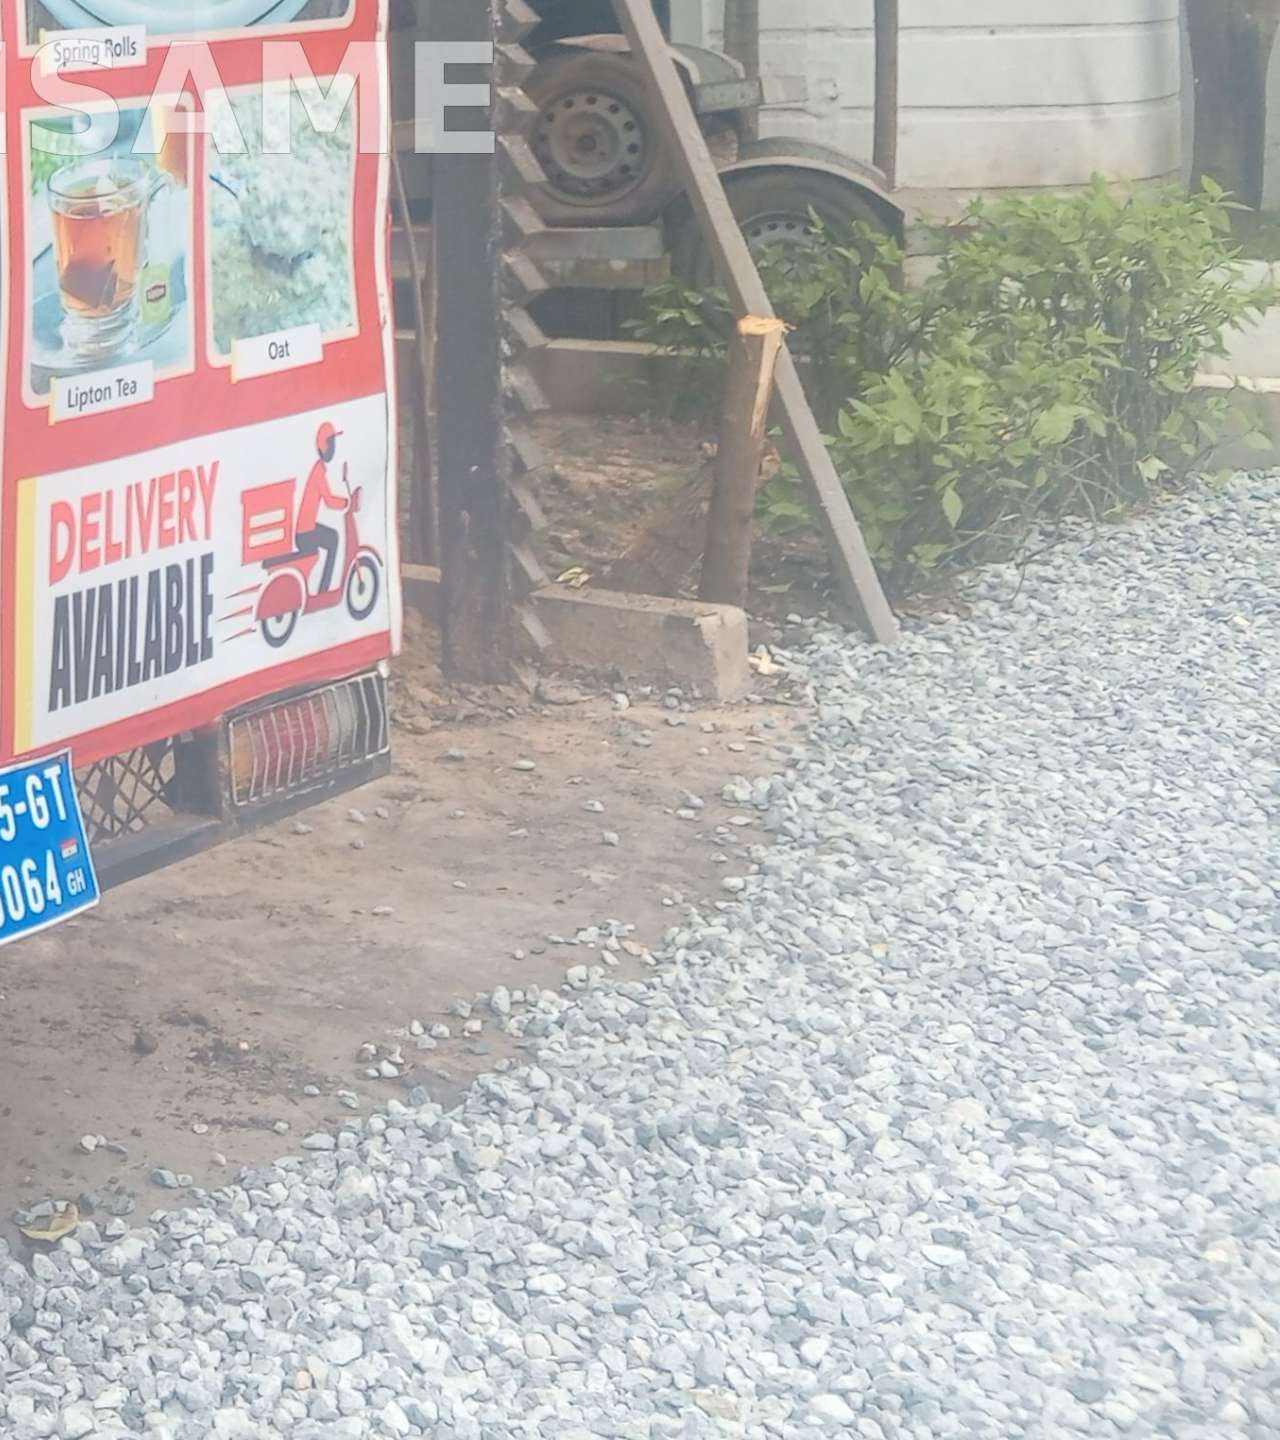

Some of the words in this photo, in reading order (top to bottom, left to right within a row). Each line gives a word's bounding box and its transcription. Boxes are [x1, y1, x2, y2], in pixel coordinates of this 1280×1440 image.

[52, 40, 105, 70] Spring
[107, 34, 138, 60] Rolls
[267, 340, 290, 361] Oat
[66, 382, 112, 411] Lipton
[115, 378, 138, 398] Tea
[48, 460, 220, 588] DELIVERY
[47, 551, 215, 713] AVAILABLE
[66, 867, 86, 895] GH
